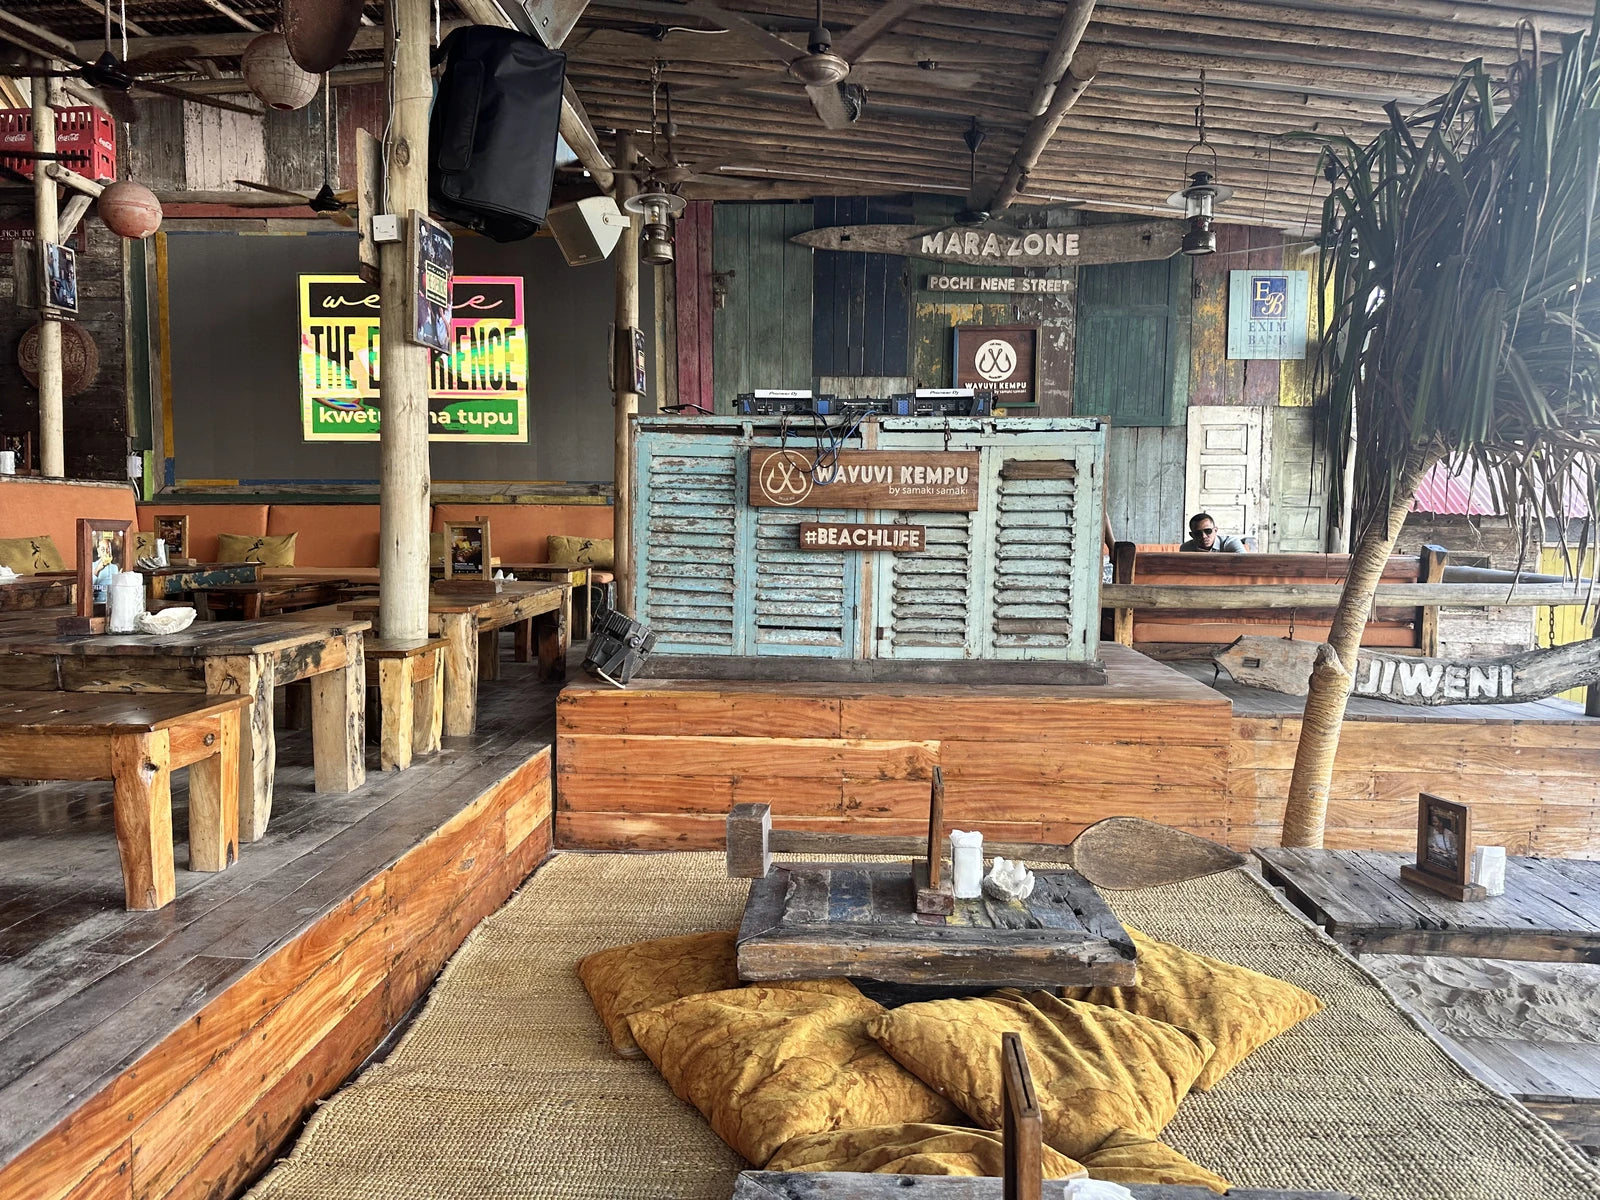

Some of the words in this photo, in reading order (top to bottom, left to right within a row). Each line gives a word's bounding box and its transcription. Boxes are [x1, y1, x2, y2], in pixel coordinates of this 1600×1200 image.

[921, 231, 1001, 256] MARA
[1007, 233, 1080, 256] ZONE
[930, 276, 974, 290] POCHI
[980, 277, 1015, 291] NENE
[1022, 279, 1070, 292] STREET
[1248, 321, 1287, 332] EXIM
[1248, 335, 1288, 346] BANK
[310, 325, 357, 389] THE
[965, 382, 997, 390] WAVUVI
[999, 382, 1027, 390] KEMPU
[320, 407, 380, 424] kwet
[457, 409, 513, 428] tupu
[816, 465, 893, 485] WAVUVI
[900, 466, 969, 485] KEMPU
[888, 485, 900, 495] by
[902, 485, 934, 495] samaki
[936, 486, 968, 495] samaki
[805, 528, 920, 547] #BEACHLIFE
